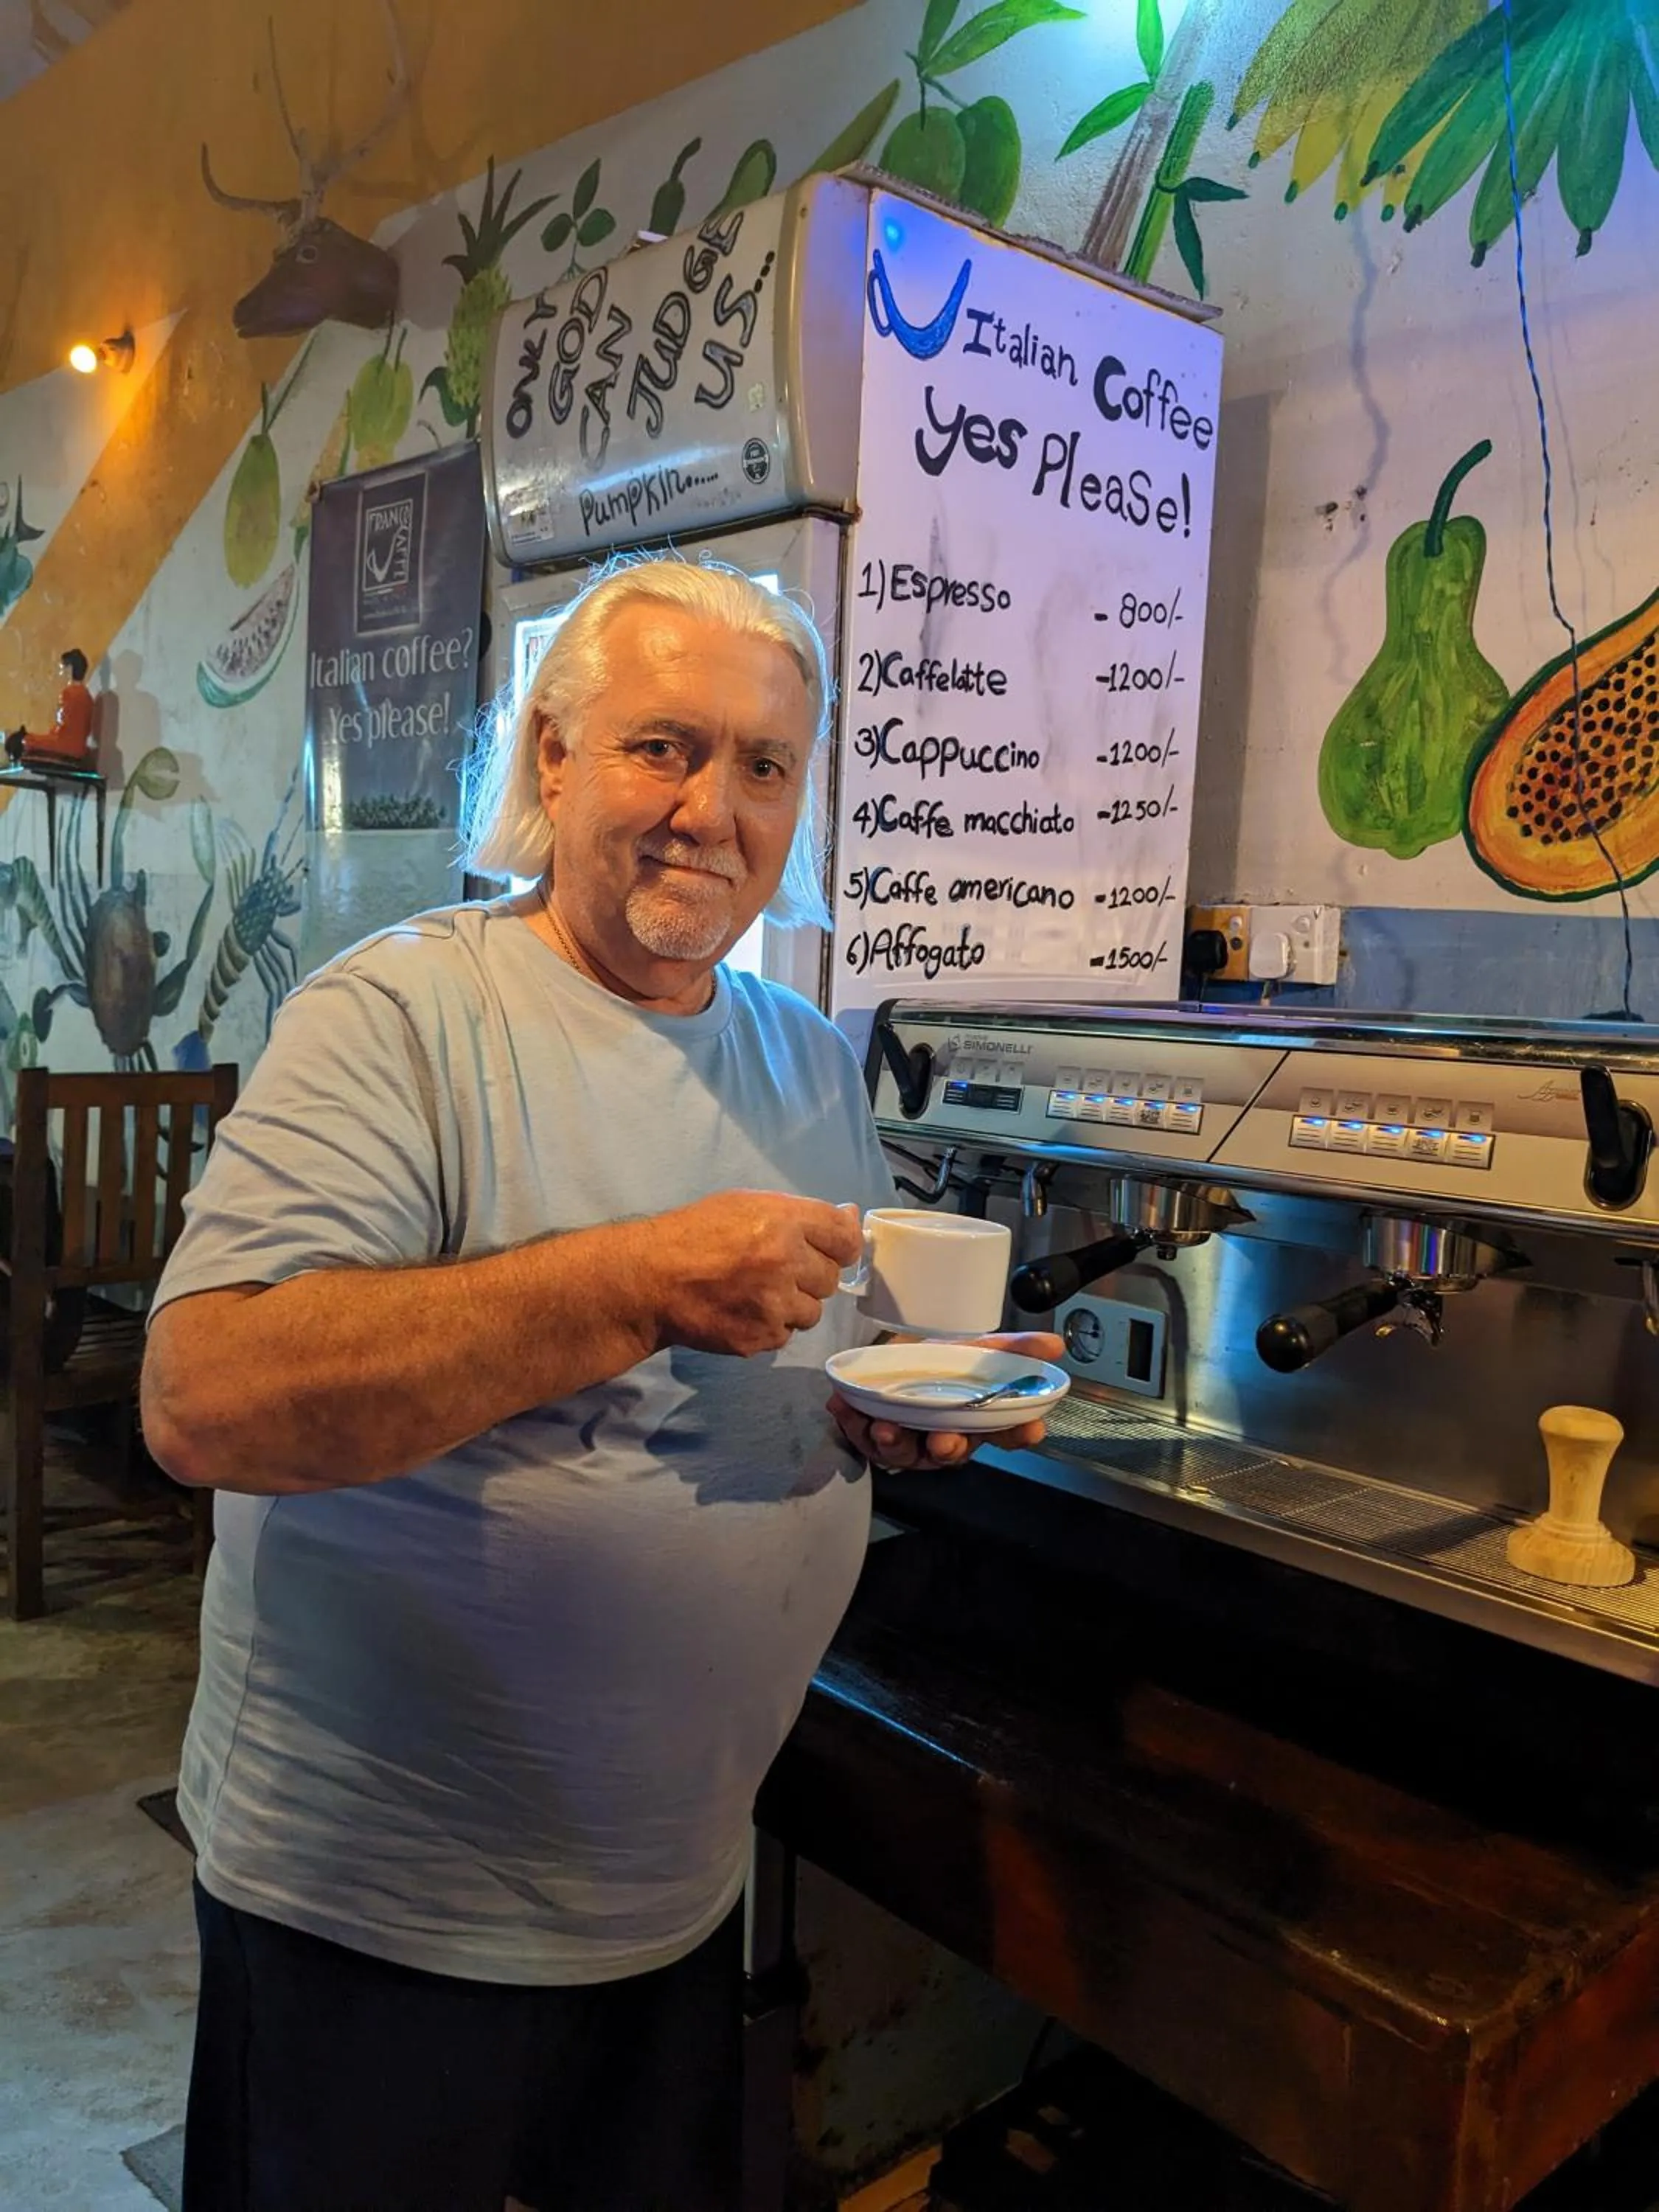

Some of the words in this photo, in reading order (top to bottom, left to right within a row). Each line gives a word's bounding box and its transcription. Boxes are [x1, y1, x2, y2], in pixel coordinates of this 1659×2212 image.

[549, 265, 608, 425] GOD
[627, 212, 745, 439] JUDGE
[579, 304, 633, 472] CAN
[962, 307, 1078, 386] Italian
[1093, 355, 1214, 450] Coffee
[310, 648, 375, 689] Italian
[381, 627, 473, 680] coffee?
[329, 706, 364, 744] Yes
[368, 691, 451, 749] please!
[964, 800, 1075, 836] macchiato
[948, 877, 1075, 910] americano
[963, 1040, 1033, 1054] SIMONELLI
